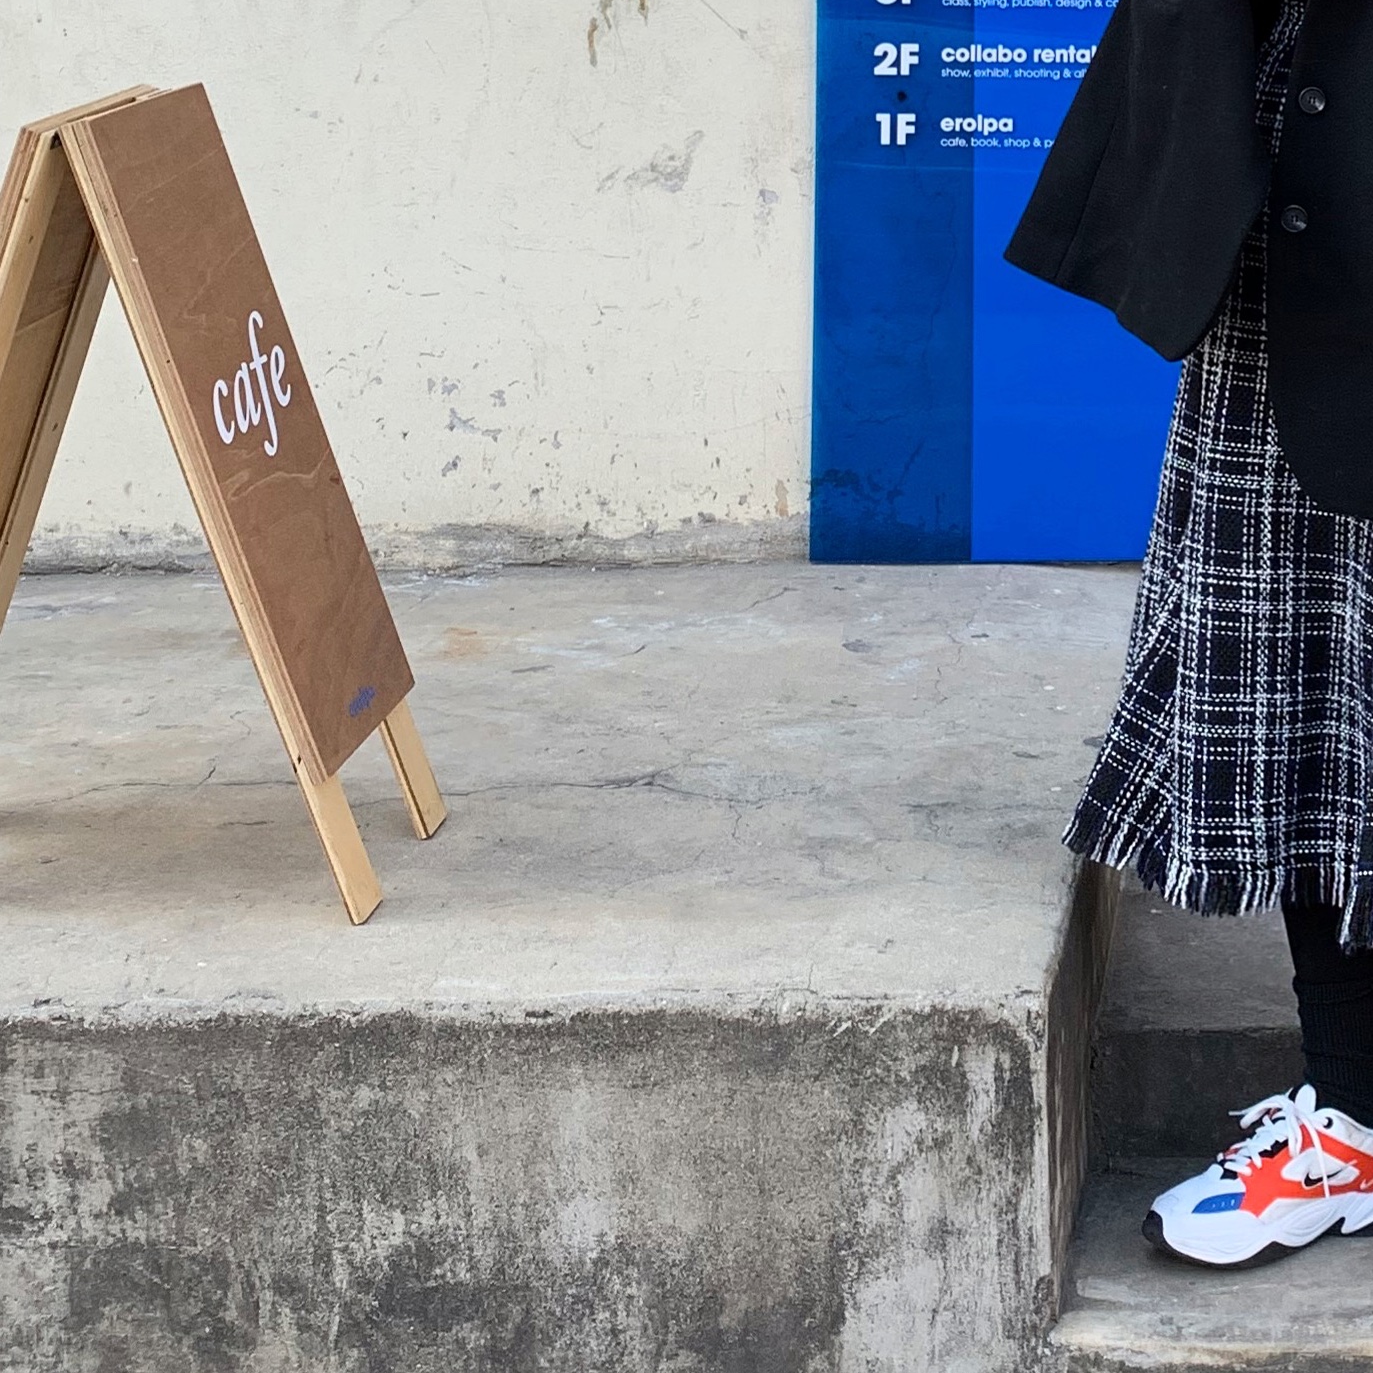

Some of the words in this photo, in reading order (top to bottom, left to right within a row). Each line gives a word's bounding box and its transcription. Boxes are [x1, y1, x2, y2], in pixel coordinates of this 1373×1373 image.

[873, 42, 919, 76] 2F
[941, 44, 1027, 63] collabo
[941, 68, 971, 78] show,
[974, 67, 1011, 78] exhibit,
[1014, 68, 1060, 81] shooting
[1063, 68, 1071, 78] &
[875, 113, 916, 145] 1F
[940, 114, 1014, 136] erolpa
[940, 137, 968, 147] cafe,
[971, 137, 1001, 148] book,
[1004, 138, 1030, 149] shop
[1033, 137, 1041, 147] &
[212, 310, 291, 457] cafe
